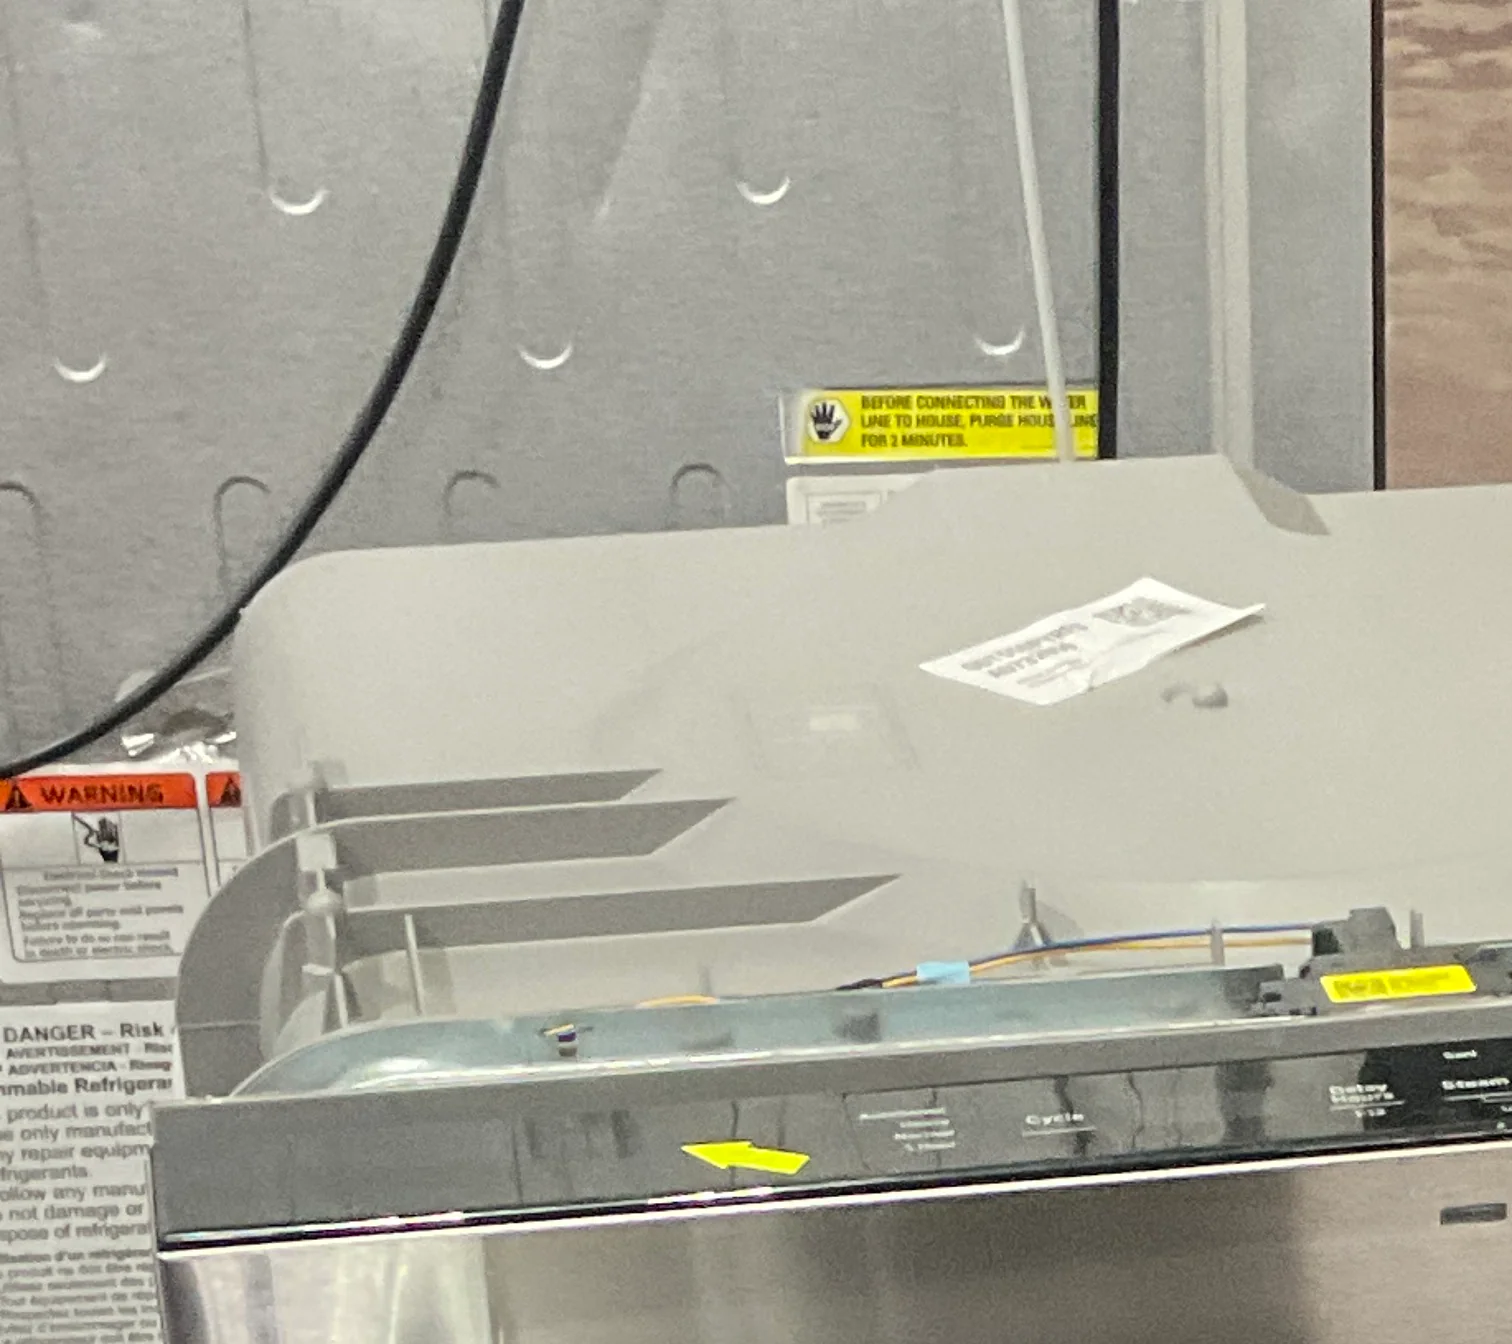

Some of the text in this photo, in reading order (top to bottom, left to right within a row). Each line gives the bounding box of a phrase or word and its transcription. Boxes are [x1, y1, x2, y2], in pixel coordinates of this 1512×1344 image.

[861, 395, 911, 409] BEFORE
[916, 395, 1005, 409] CONNECTING
[1009, 395, 1036, 409] THE
[893, 414, 910, 428] TO
[861, 433, 887, 447] FOR
[891, 434, 898, 447] 2
[40, 783, 164, 804] WARNING
[3, 1024, 95, 1043] DANGER
[119, 1021, 164, 1038] Risk
[1328, 1083, 1387, 1094] Delay
[1441, 1077, 1511, 1090] Steam
[1330, 1092, 1395, 1104] Hours
[7, 1102, 142, 1124] product is only
[1024, 1111, 1085, 1128] Cycle
[20, 1124, 59, 1143] only
[21, 1146, 74, 1162] repair
[53, 1186, 85, 1202] any
[9, 1205, 38, 1220] not
[44, 1203, 120, 1222] damage
[54, 1223, 70, 1239] of
